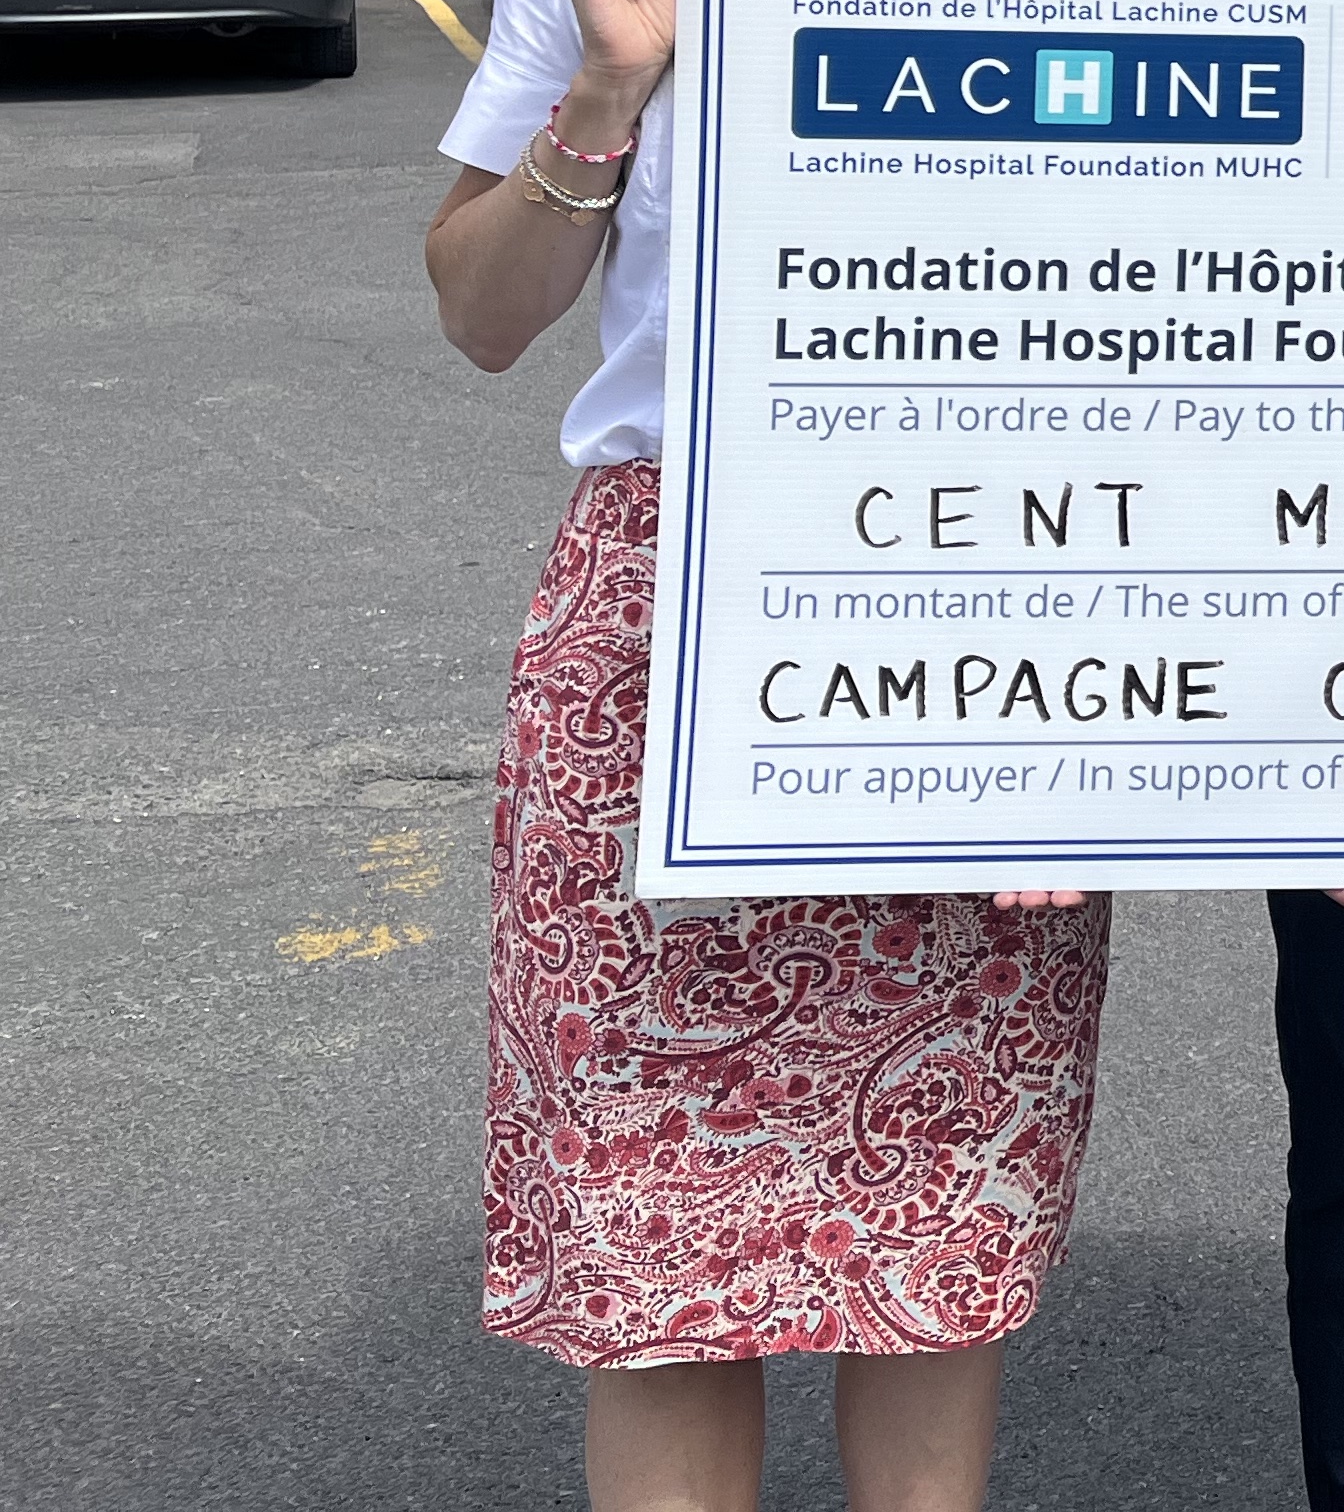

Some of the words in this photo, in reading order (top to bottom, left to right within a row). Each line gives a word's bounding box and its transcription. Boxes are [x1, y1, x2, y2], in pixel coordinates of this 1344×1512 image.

[1112, 1, 1219, 23] Lachine
[1228, 3, 1307, 25] CUSM
[815, 52, 1282, 120] LACHINE
[789, 151, 903, 174] Lachine
[914, 153, 1035, 180] Hospital
[1044, 154, 1204, 177] Foundation
[1216, 156, 1302, 178] MUHC
[777, 246, 1068, 292] Fondation
[1089, 247, 1156, 293] de
[775, 315, 999, 361] Lachine
[1019, 317, 1254, 375] Hospital
[771, 398, 886, 442] Payer
[898, 396, 920, 432] à
[1082, 397, 1132, 432] de
[1143, 399, 1161, 432] /
[1174, 399, 1245, 442] Pay
[1255, 401, 1295, 432] to
[855, 481, 1144, 549] CENT
[763, 585, 818, 620] Un
[834, 587, 1013, 619] montant
[1025, 583, 1075, 619] de
[1086, 584, 1104, 618] /
[1114, 583, 1189, 618] The
[1203, 591, 1288, 618] sum
[759, 654, 1228, 724] CAMPAGNE
[752, 761, 851, 795] Pour
[863, 765, 1038, 804] appuyer
[1047, 757, 1066, 792] /
[1079, 757, 1113, 792] In
[1128, 759, 1290, 801] support
[1302, 754, 1344, 790] of
